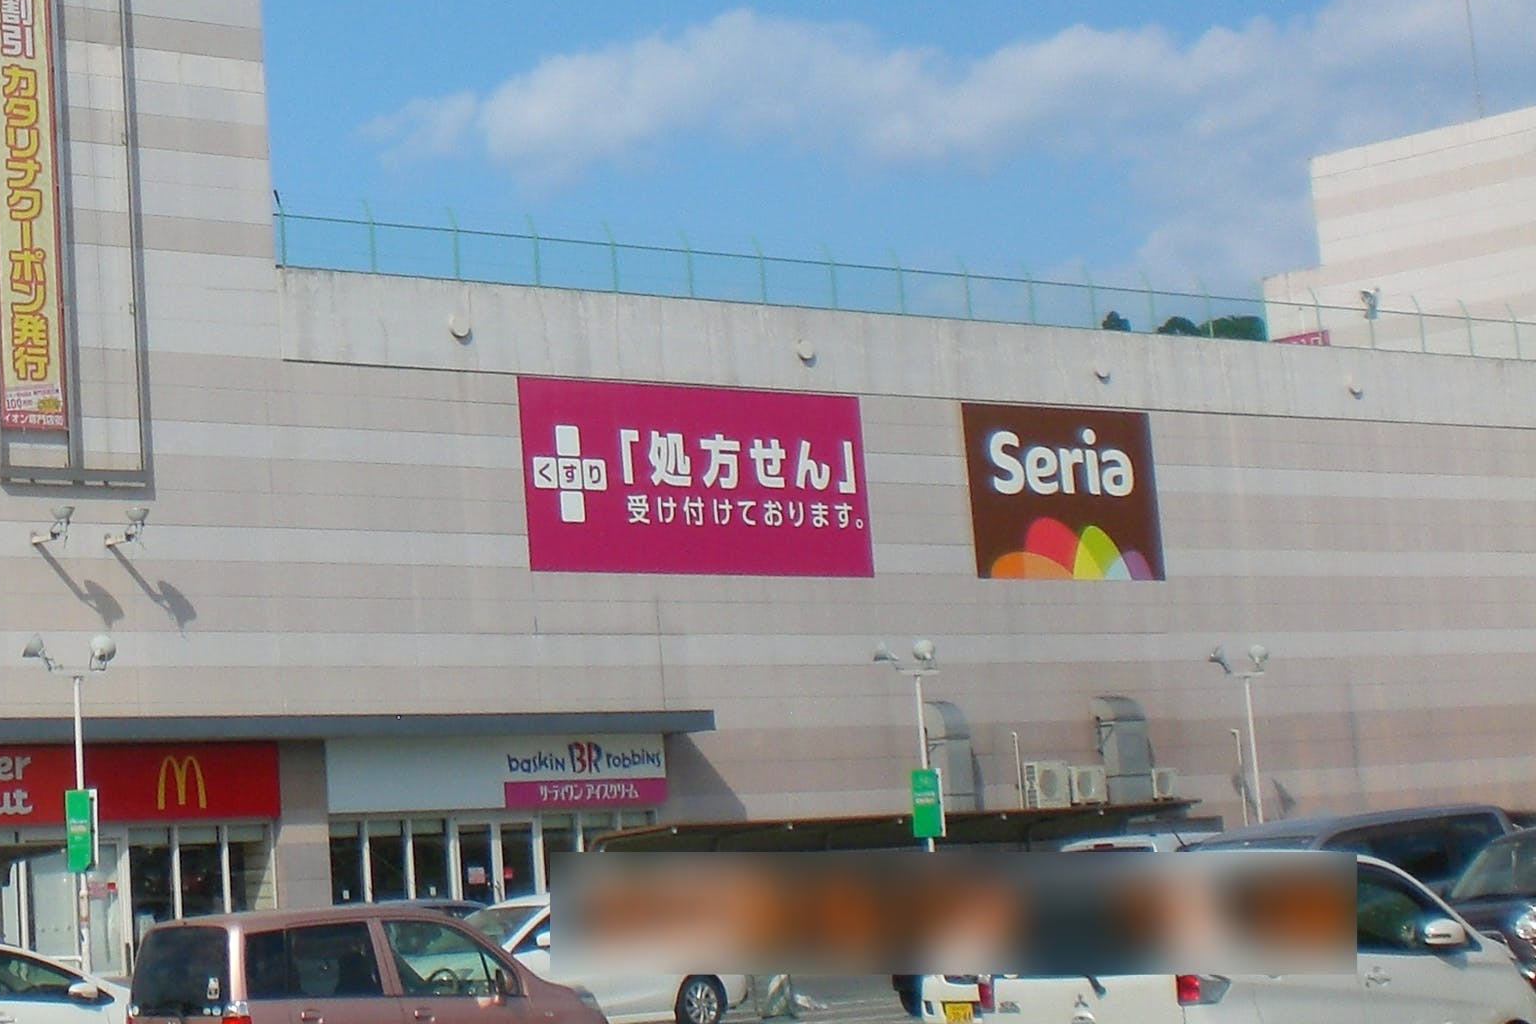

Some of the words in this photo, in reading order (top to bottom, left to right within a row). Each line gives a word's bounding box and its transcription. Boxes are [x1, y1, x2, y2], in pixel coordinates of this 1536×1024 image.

[539, 463, 601, 484] くすり
[990, 428, 1134, 496] Seria
[627, 494, 864, 529] 受け付けております。
[507, 751, 566, 774] baskin
[606, 749, 661, 769] robbins
